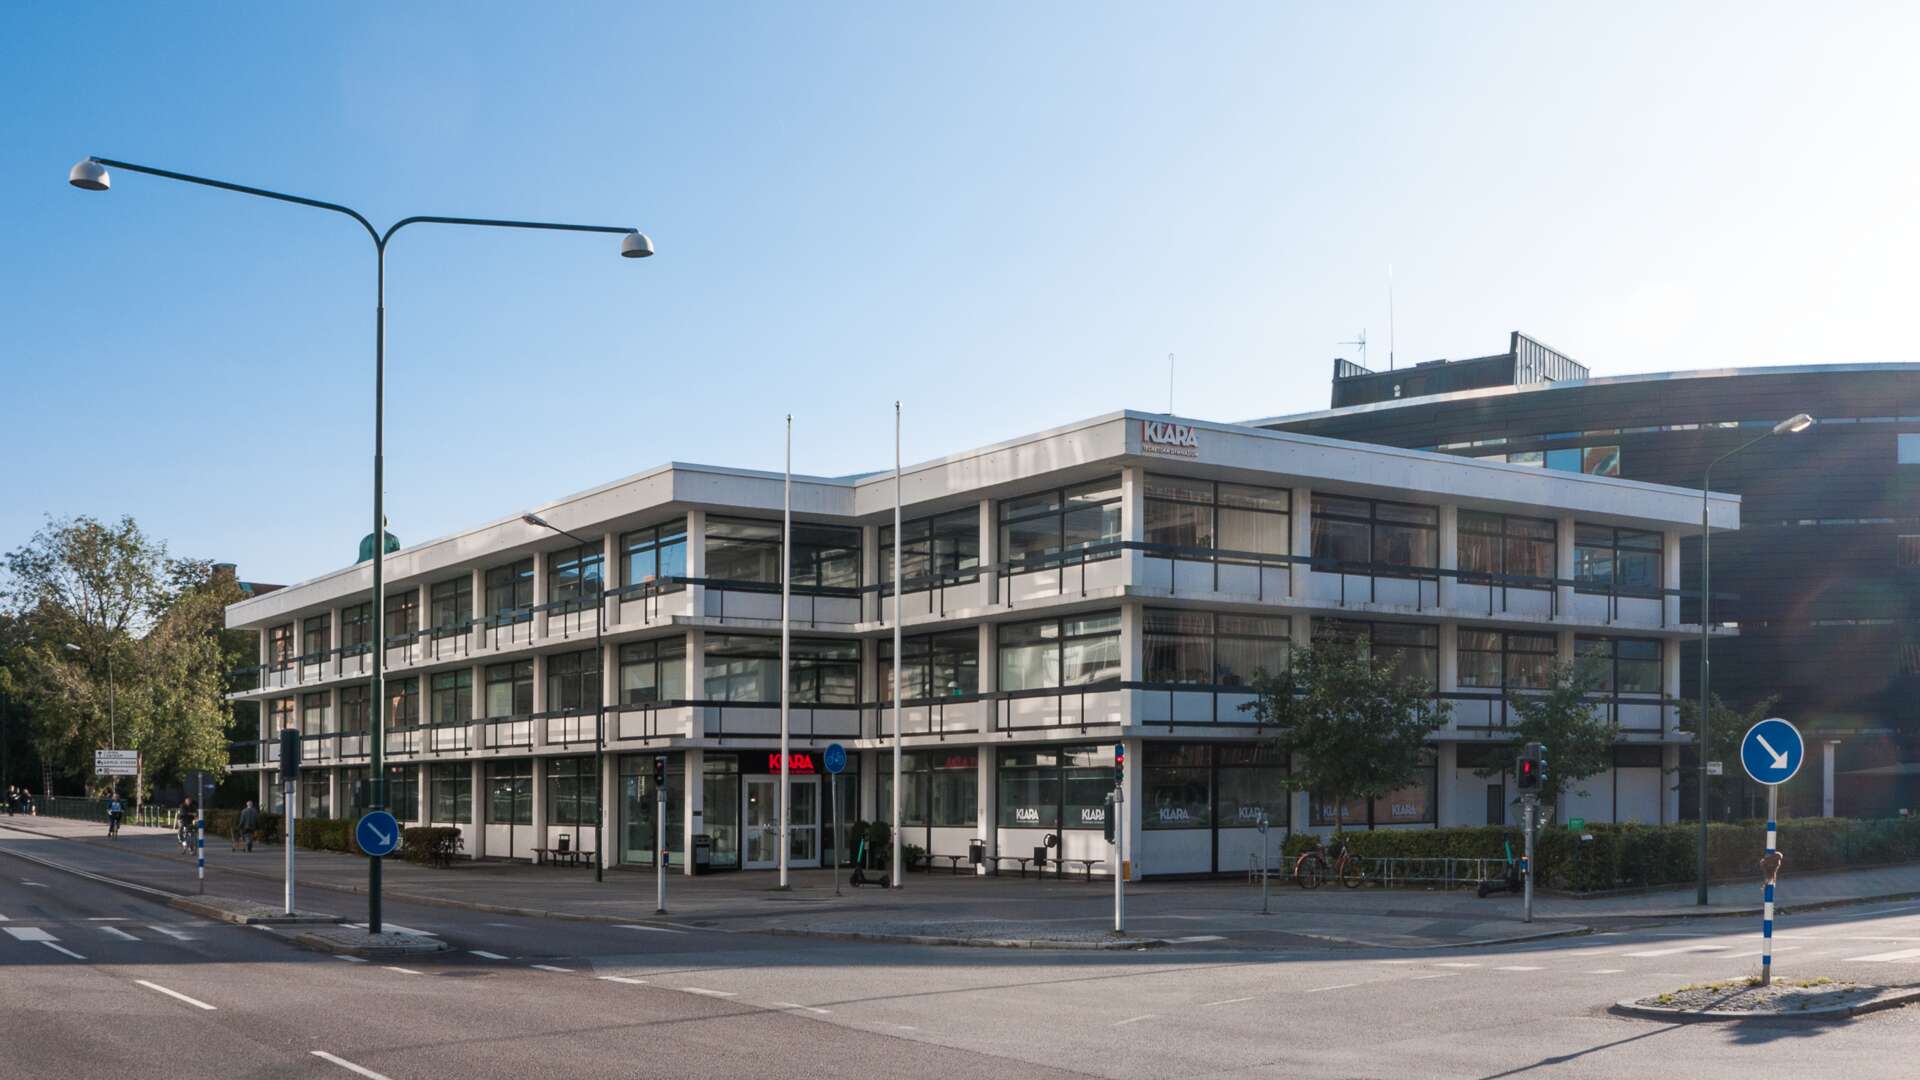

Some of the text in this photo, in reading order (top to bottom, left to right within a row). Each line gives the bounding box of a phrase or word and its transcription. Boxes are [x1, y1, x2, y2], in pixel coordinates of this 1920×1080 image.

[1142, 420, 1199, 448] KLARA
[1016, 808, 1039, 820] KLARA
[1160, 808, 1190, 820] KLARA
